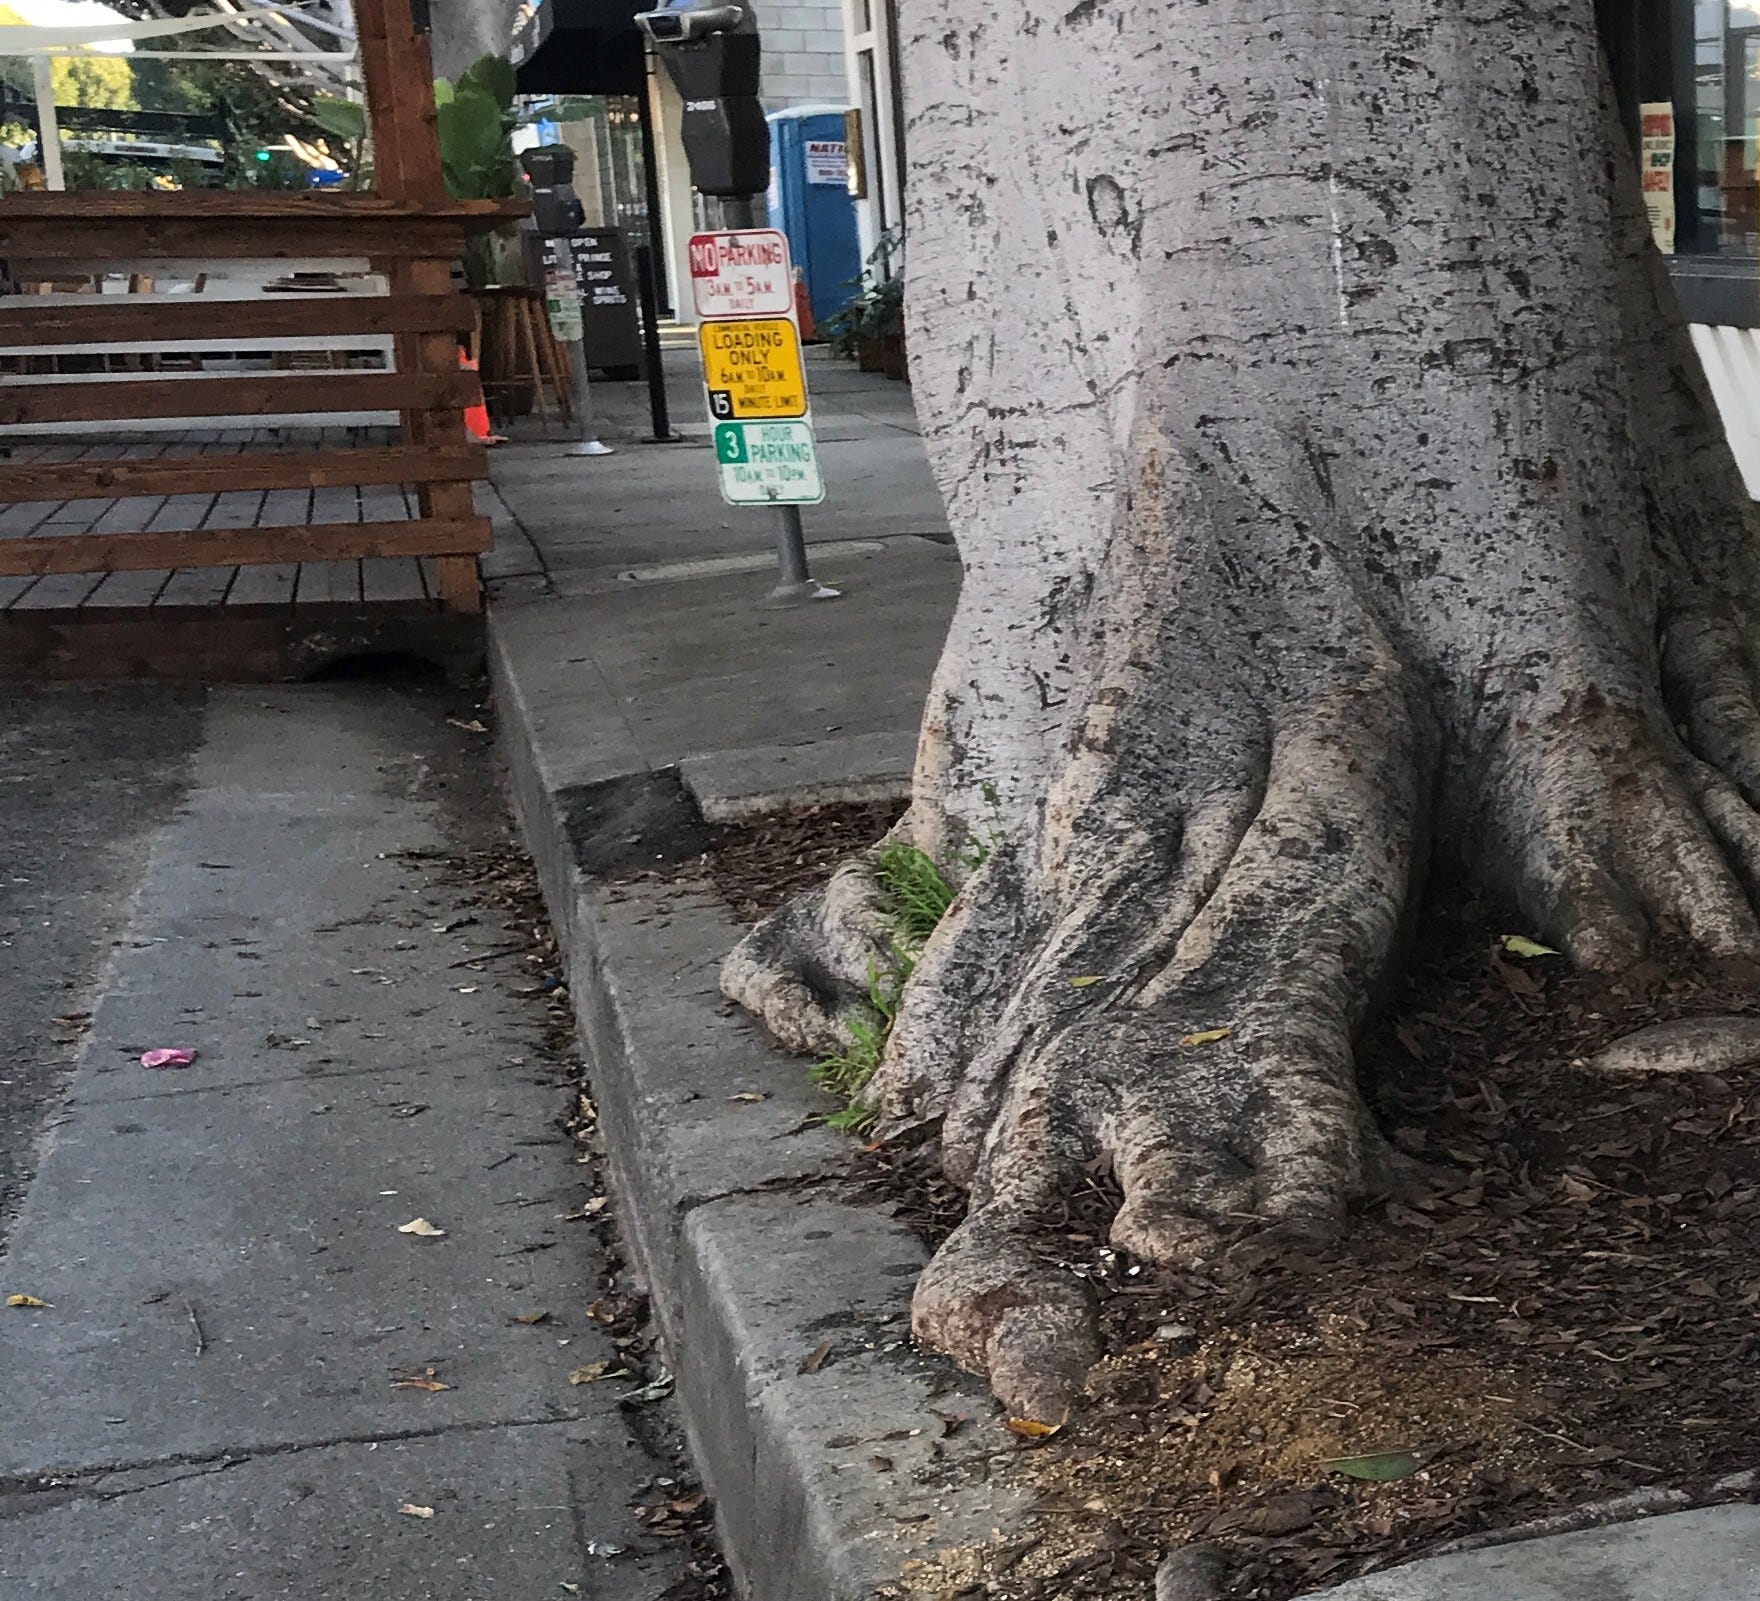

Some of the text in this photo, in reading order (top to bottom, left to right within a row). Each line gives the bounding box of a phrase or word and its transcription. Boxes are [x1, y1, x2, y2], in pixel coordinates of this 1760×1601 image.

[691, 242, 782, 272] NO PARKING
[713, 331, 784, 350] LOADING
[729, 349, 770, 366] ONLY
[713, 393, 799, 415] 15 MINUTE LIMIT
[724, 426, 792, 459] 3 HOUR
[750, 442, 811, 463] PARKING
